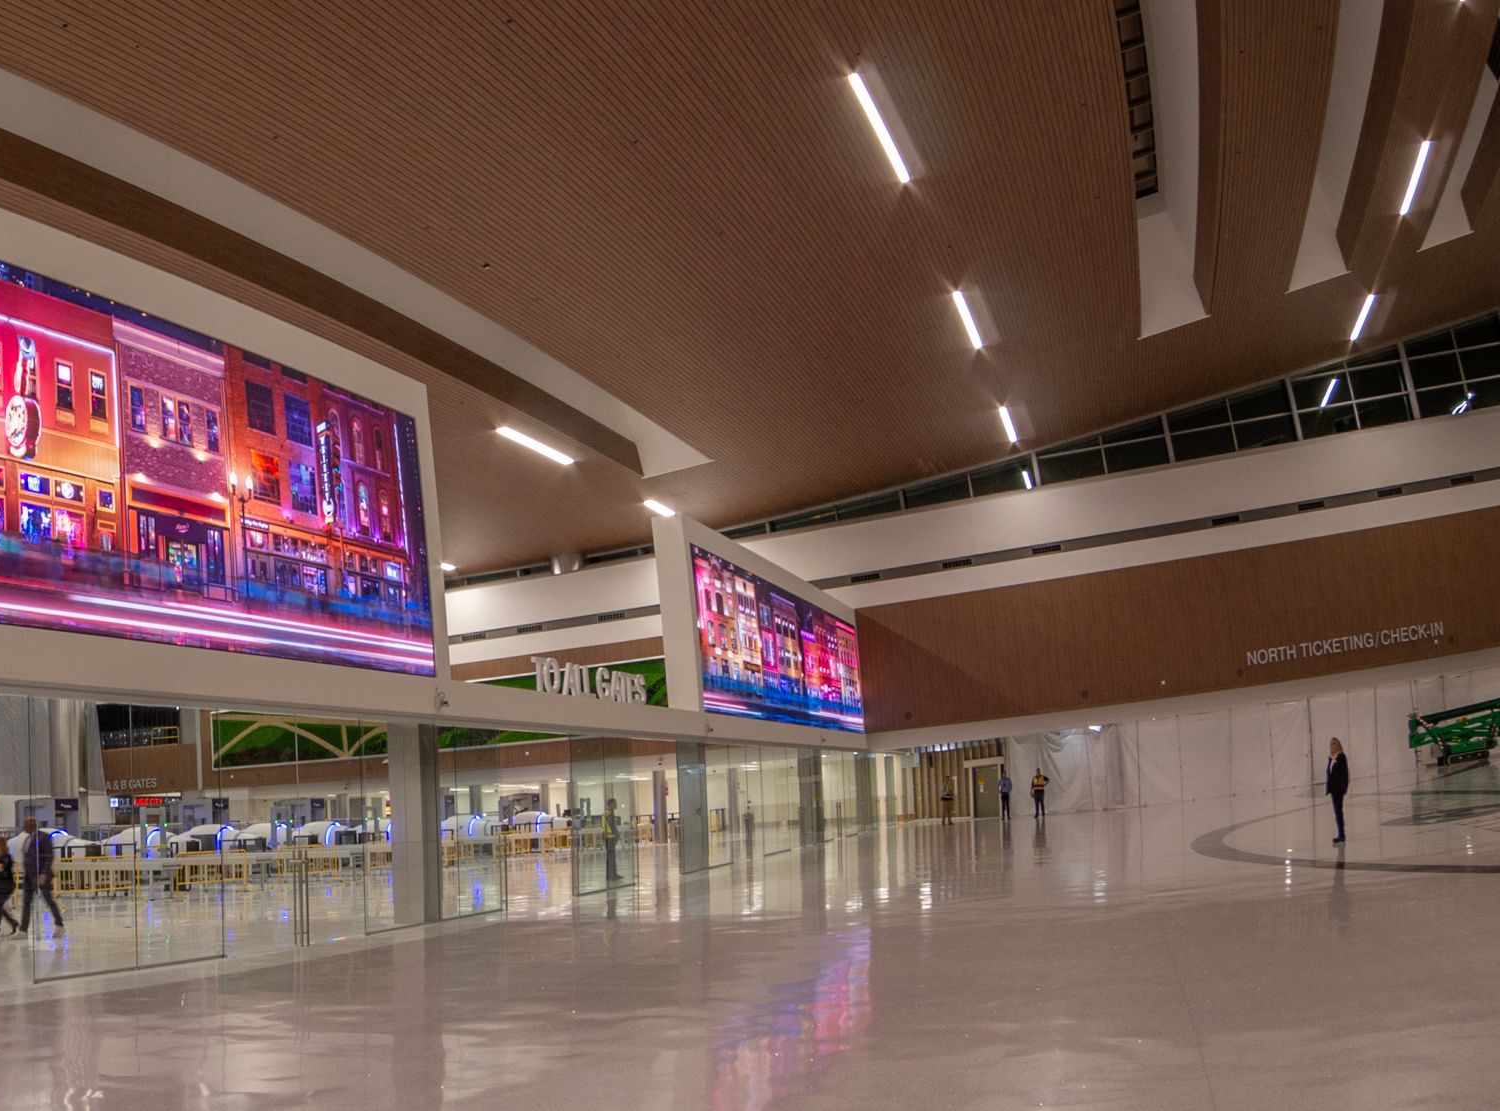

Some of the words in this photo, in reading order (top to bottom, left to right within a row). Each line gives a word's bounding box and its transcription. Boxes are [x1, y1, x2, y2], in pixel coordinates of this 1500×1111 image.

[1246, 644, 1297, 666] NORTH
[1300, 621, 1445, 658] TICKETING/CHECK-IN
[531, 655, 561, 694] TO
[562, 662, 596, 696] ALL
[596, 667, 647, 705] GATES
[105, 781, 112, 790] A
[113, 780, 120, 790] &
[120, 780, 127, 790] B
[128, 778, 158, 790] GATES
